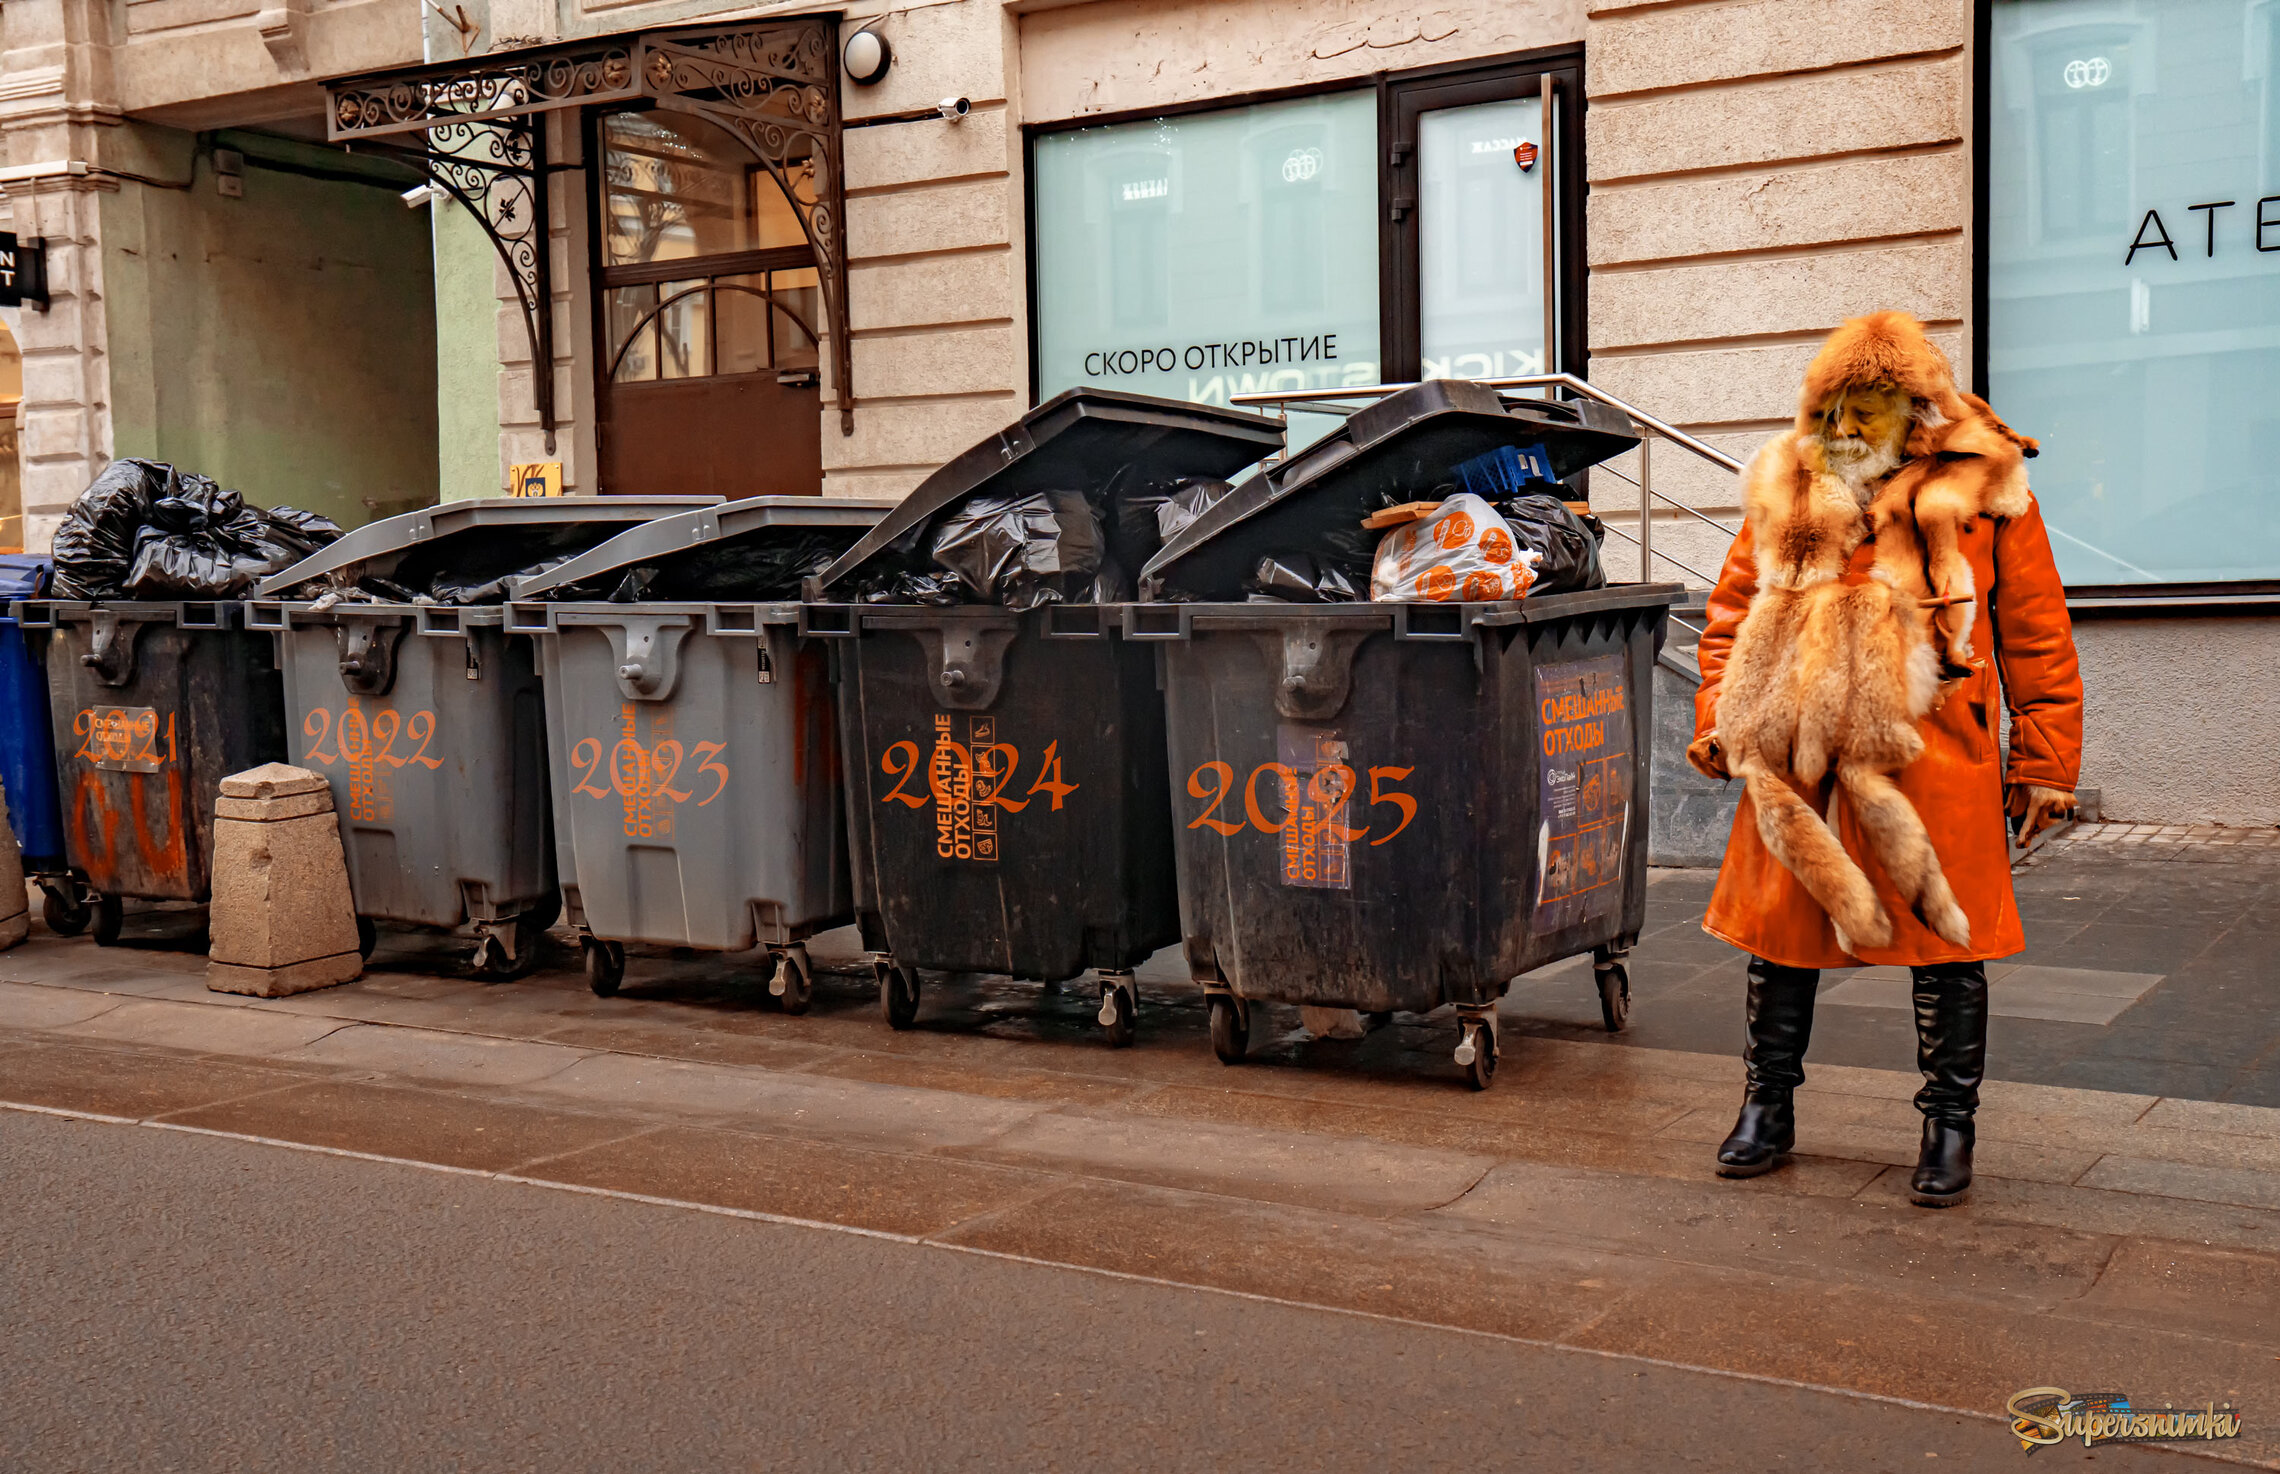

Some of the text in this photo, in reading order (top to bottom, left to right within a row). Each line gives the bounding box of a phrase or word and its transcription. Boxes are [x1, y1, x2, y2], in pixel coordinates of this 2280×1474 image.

[1084, 334, 1338, 377] СКОРО ОТКРЫТИЕ
[1541, 685, 1625, 726] СМЕШАННЫЕ
[1543, 720, 1604, 757] ОТХОДЫ
[622, 702, 637, 837] СМЕШАННЫЕ
[637, 748, 652, 838] ОТХОДЫ
[935, 713, 954, 858] СМЕШАННЫЕ
[953, 763, 971, 860] ОТХОДЫ
[1301, 805, 1317, 881] ОТХОДЫ
